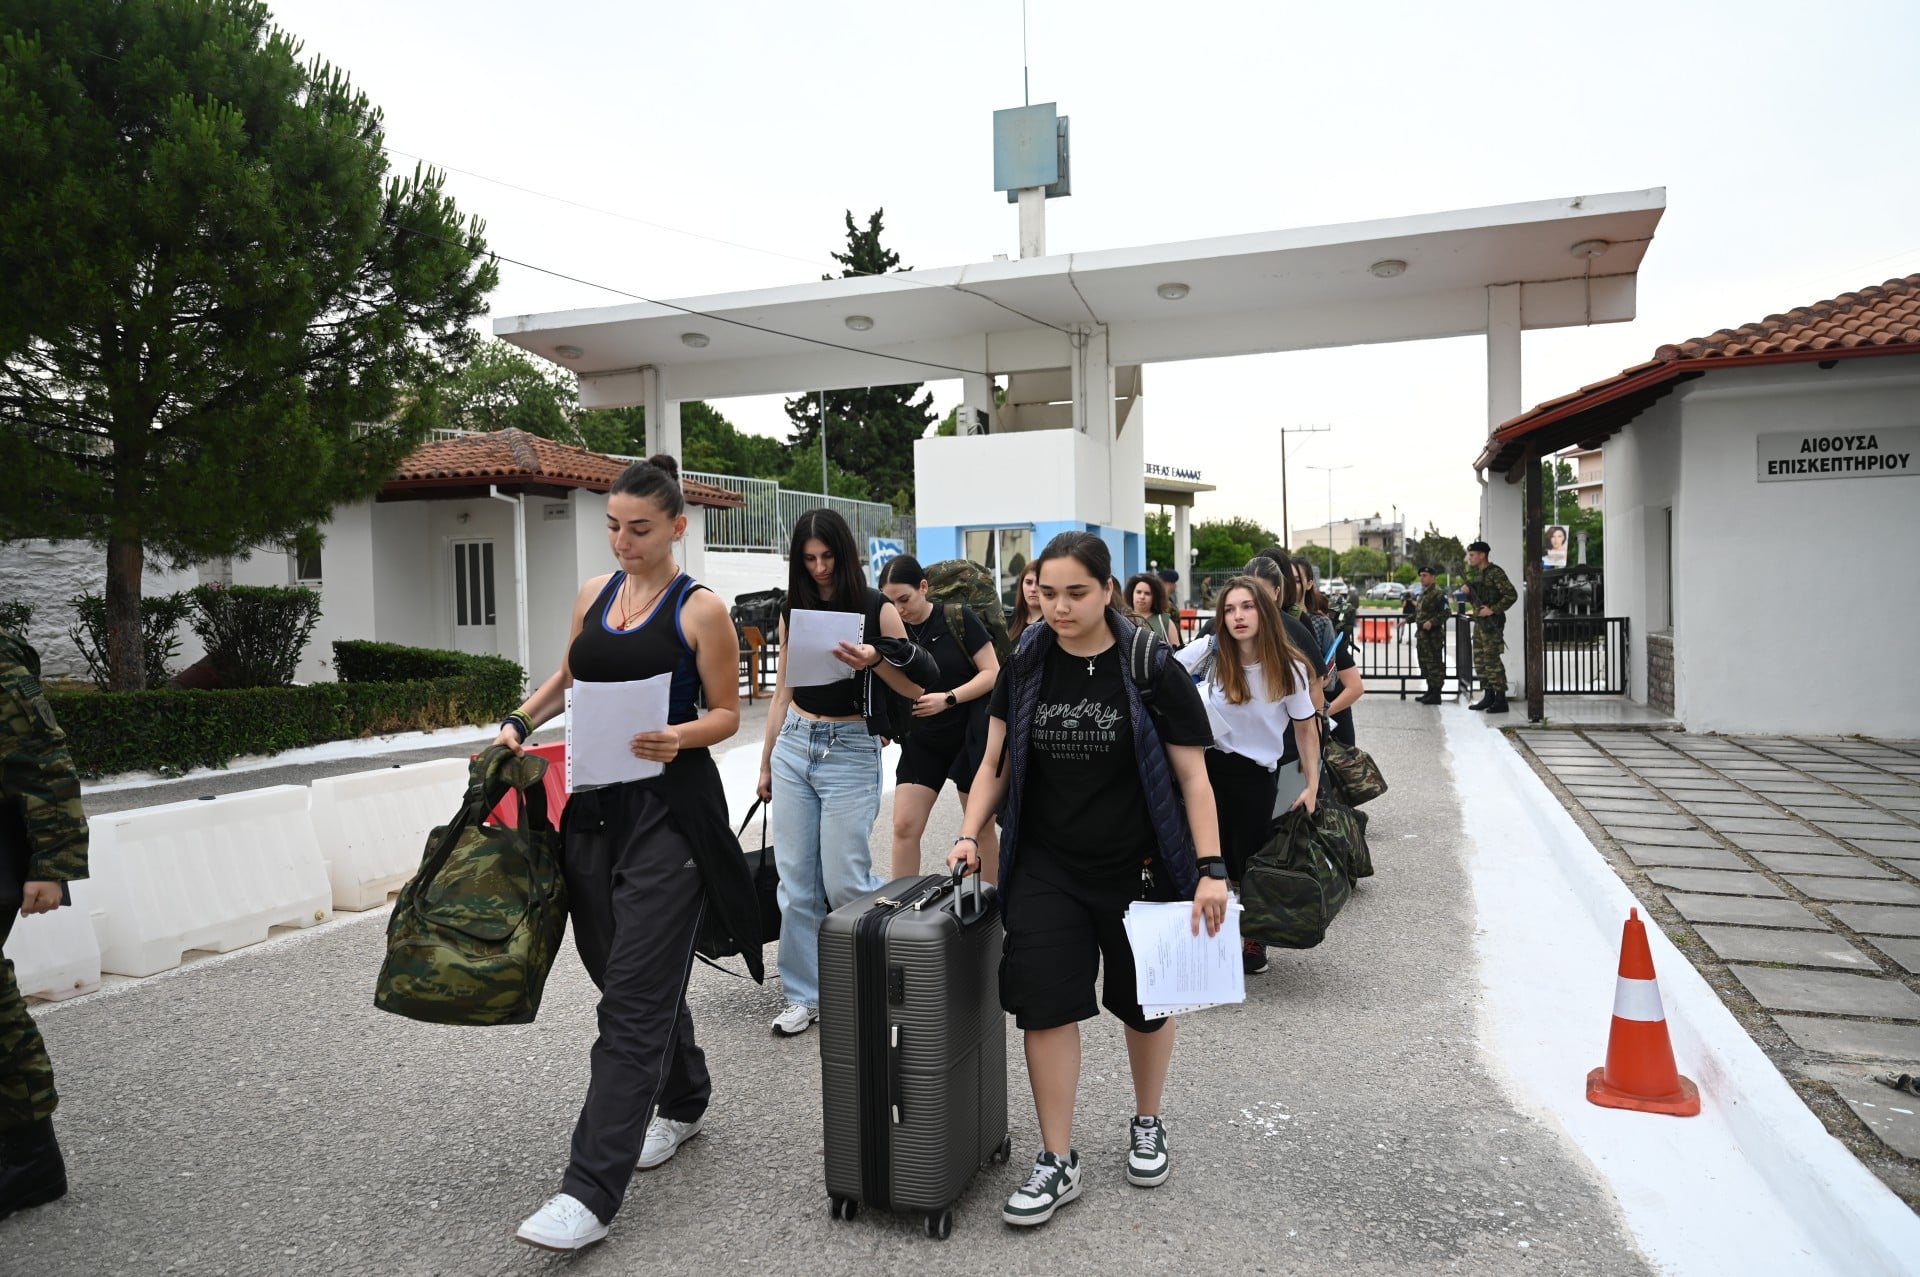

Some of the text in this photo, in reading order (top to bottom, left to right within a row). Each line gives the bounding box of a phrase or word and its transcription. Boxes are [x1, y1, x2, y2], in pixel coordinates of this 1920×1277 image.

[1800, 435, 1879, 453] ΑΙΘΟΥΣΑ
[1767, 453, 1911, 475] ΕΠΙΣΚΕΠΤΗΡΙΟΥ
[1071, 731, 1116, 741] EDITION
[1051, 743, 1080, 751] STREET
[1083, 744, 1110, 752] STYLE
